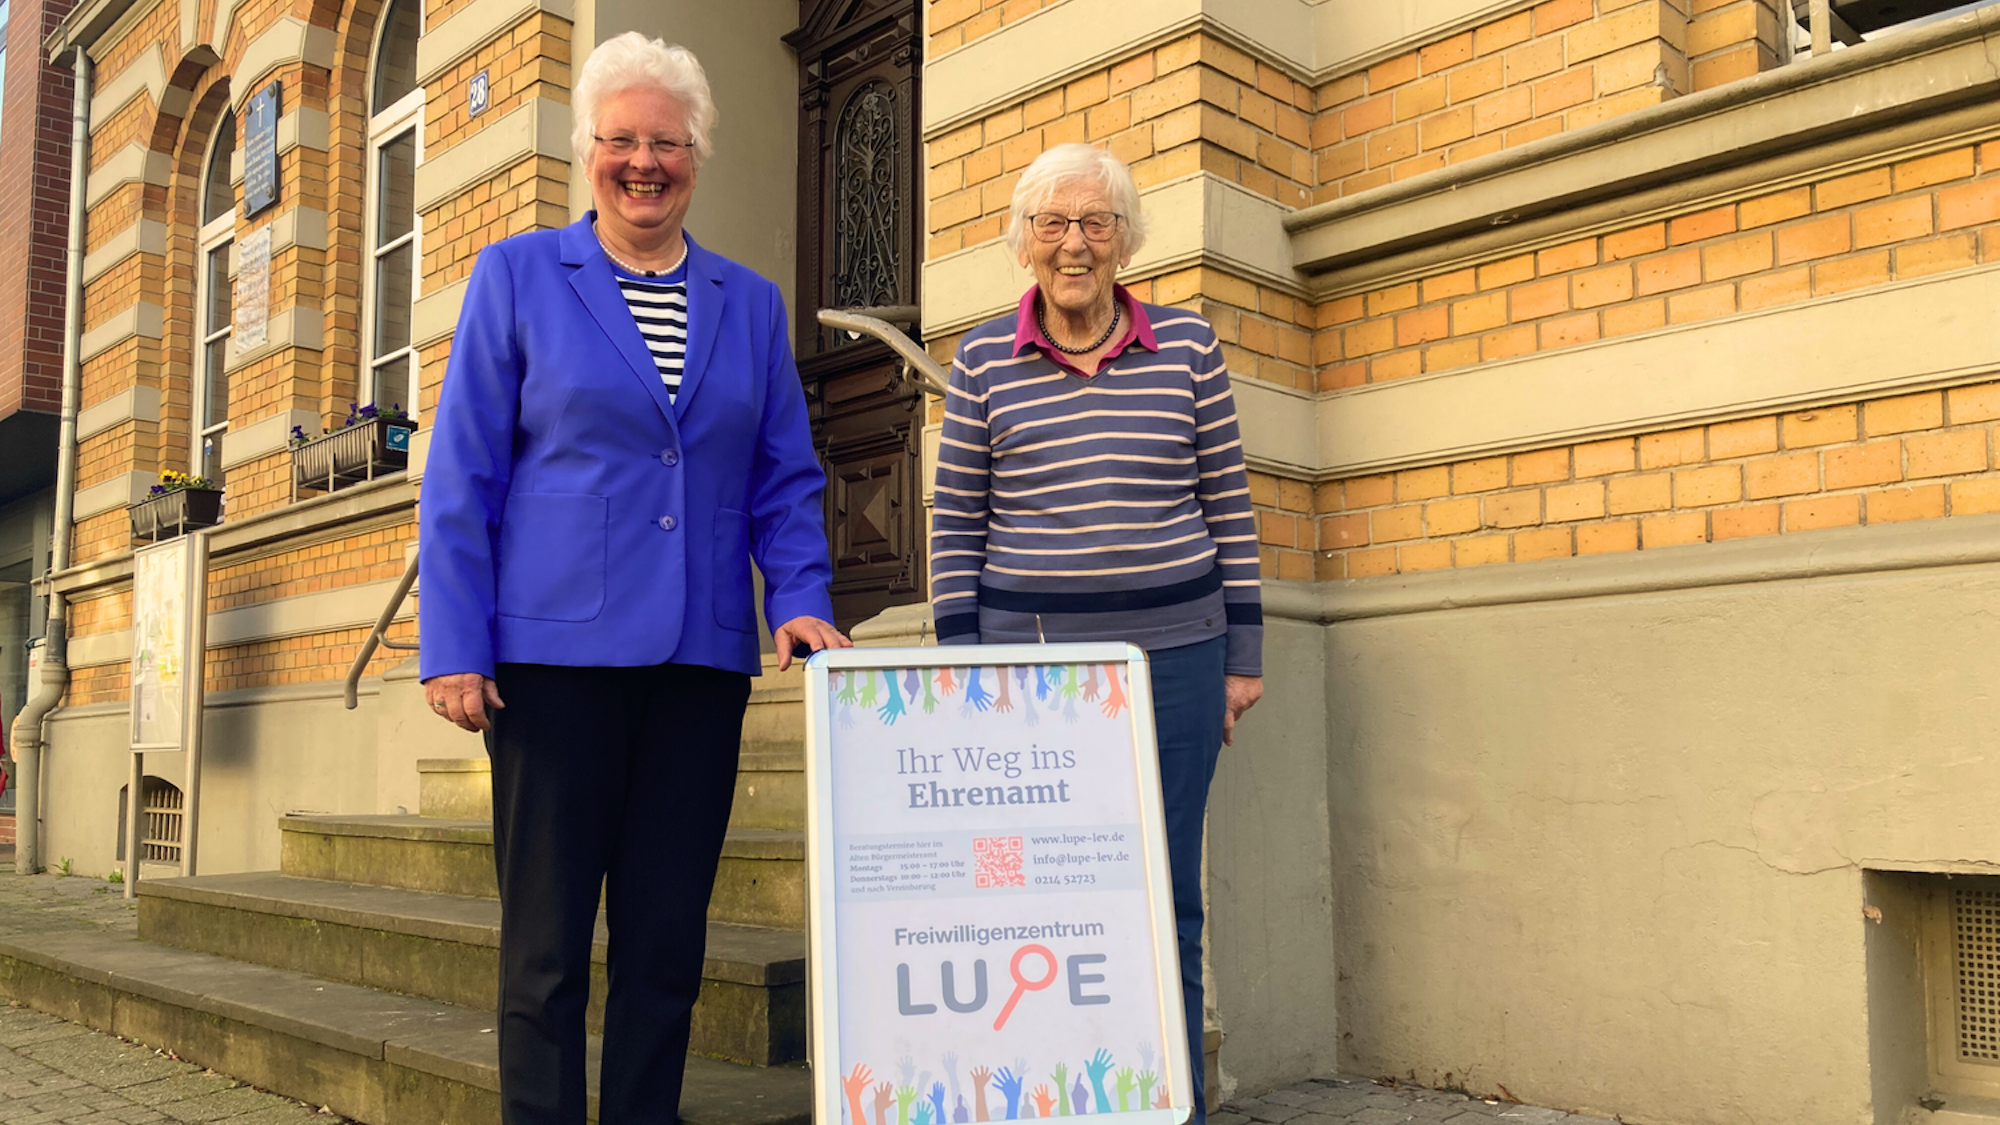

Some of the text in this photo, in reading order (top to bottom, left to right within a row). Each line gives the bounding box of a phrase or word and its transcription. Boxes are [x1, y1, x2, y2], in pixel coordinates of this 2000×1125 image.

[471, 77, 485, 108] 28
[896, 744, 1077, 778] Ihr Weg ins
[907, 778, 1071, 808] Ehrenamt
[849, 840, 943, 852] Beratungstermine hier im
[1031, 831, 1125, 846] www.lupe-lev.de
[849, 851, 938, 862] Alten Bürgermeisteramt
[1033, 851, 1130, 866] info@lupe-lev.de
[850, 864, 883, 873] Montags
[951, 860, 965, 868] Uhr
[850, 874, 898, 883] Donnerstags
[951, 870, 966, 878] Uhr
[1035, 874, 1096, 885] 0214 52723
[850, 883, 937, 893] und nach Vereinbarung
[894, 920, 1105, 946] Freiwilligenzentrum
[896, 943, 1111, 1031] LUPE
